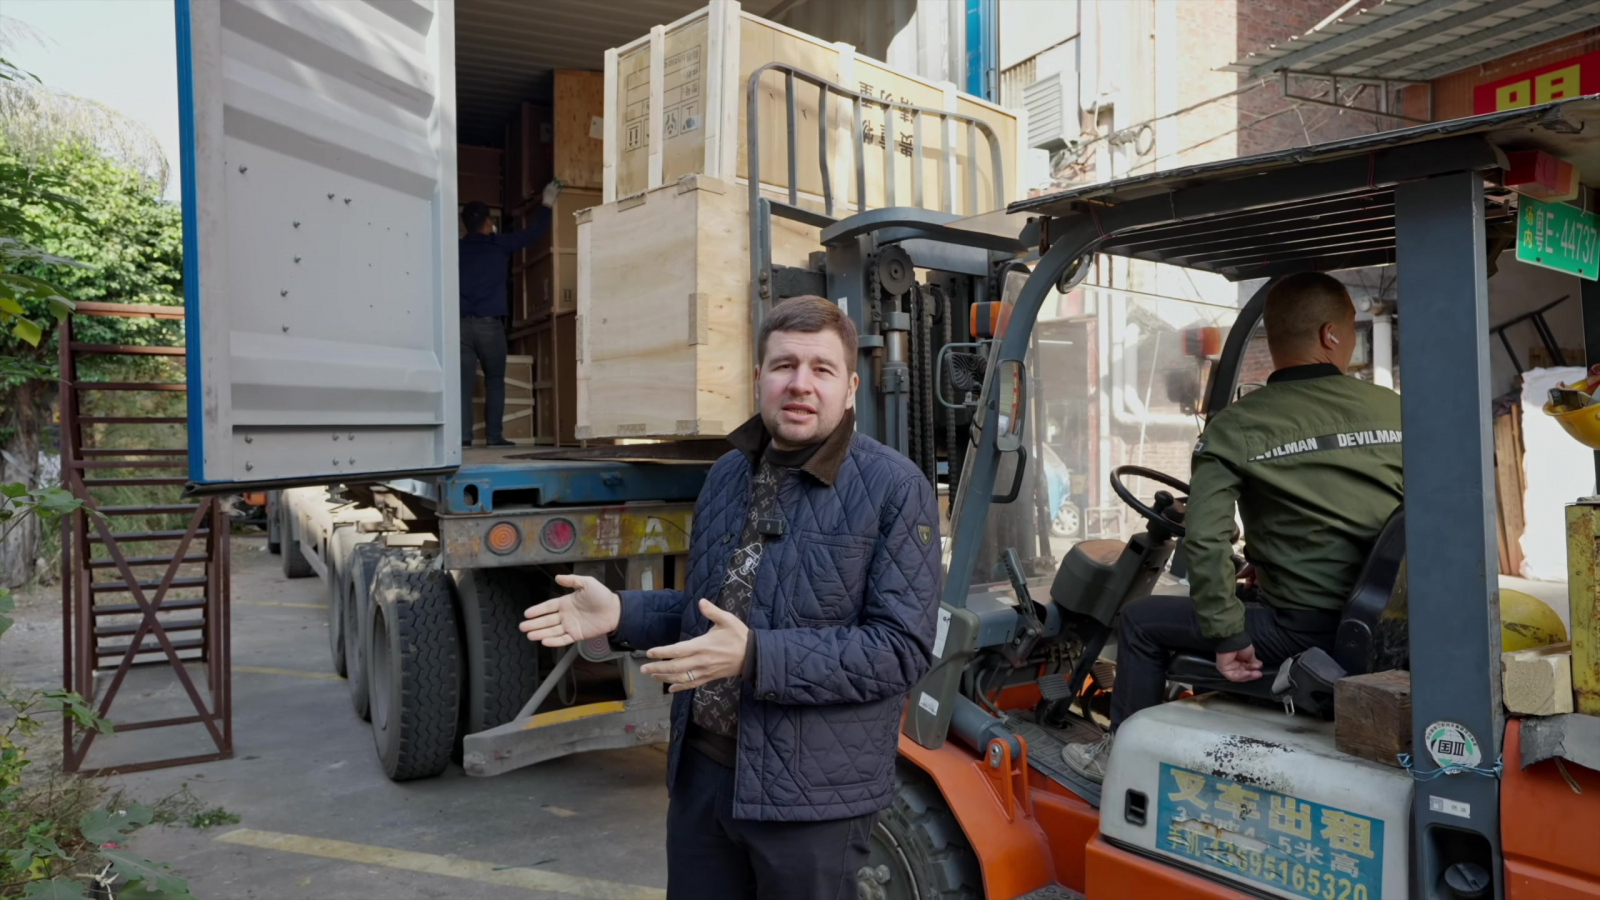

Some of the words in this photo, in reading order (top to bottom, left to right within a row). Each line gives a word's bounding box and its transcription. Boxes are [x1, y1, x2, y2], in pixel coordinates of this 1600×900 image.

[1249, 437, 1318, 461] VILMAN
[1167, 768, 1375, 859] 叉车出租
